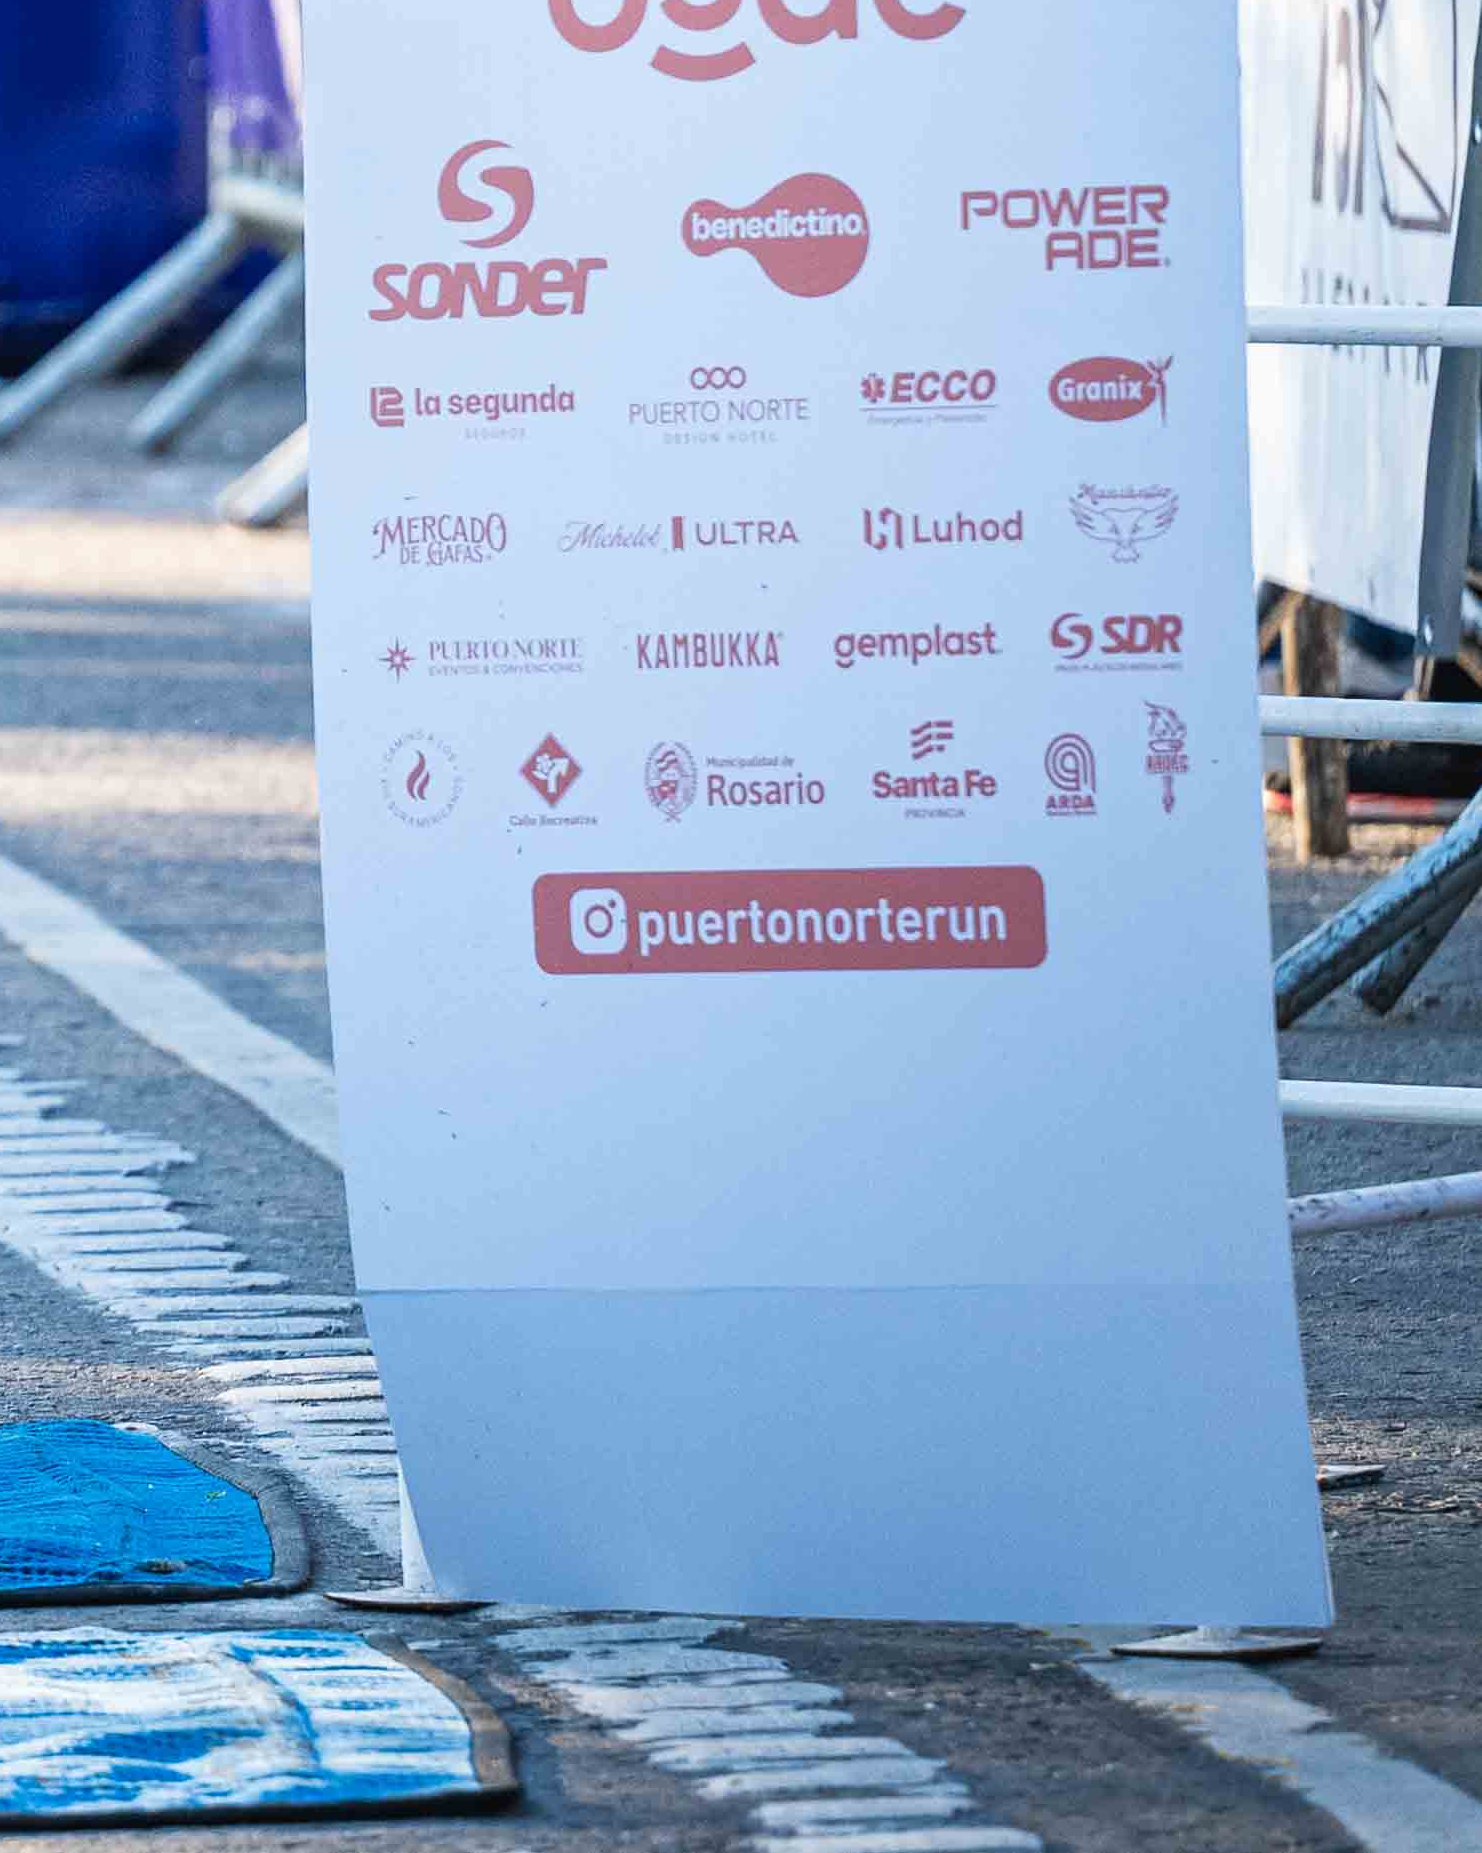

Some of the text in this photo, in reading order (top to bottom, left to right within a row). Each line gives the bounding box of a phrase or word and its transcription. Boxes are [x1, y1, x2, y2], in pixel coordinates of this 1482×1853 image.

[690, 207, 864, 243] benedictino
[961, 184, 1170, 231] POWER
[1045, 227, 1163, 272] ADE
[413, 382, 576, 422] la segunda
[890, 368, 997, 404] ECCO
[1056, 374, 1144, 403] Granix
[628, 395, 811, 426] PUERTO NORTE
[372, 512, 508, 554] MERCADO
[695, 519, 801, 547] ULTRA
[912, 509, 1024, 544] Luhod
[399, 540, 485, 566] DE GAFAS
[428, 637, 583, 662] PUERTO NORTE
[636, 630, 781, 670] KAMBUKKA
[833, 622, 997, 670] gemplast
[1100, 614, 1184, 655] SDR
[706, 771, 826, 807] Rosario
[872, 768, 998, 799] Santa Fe
[637, 897, 1009, 957] puertonorterun
